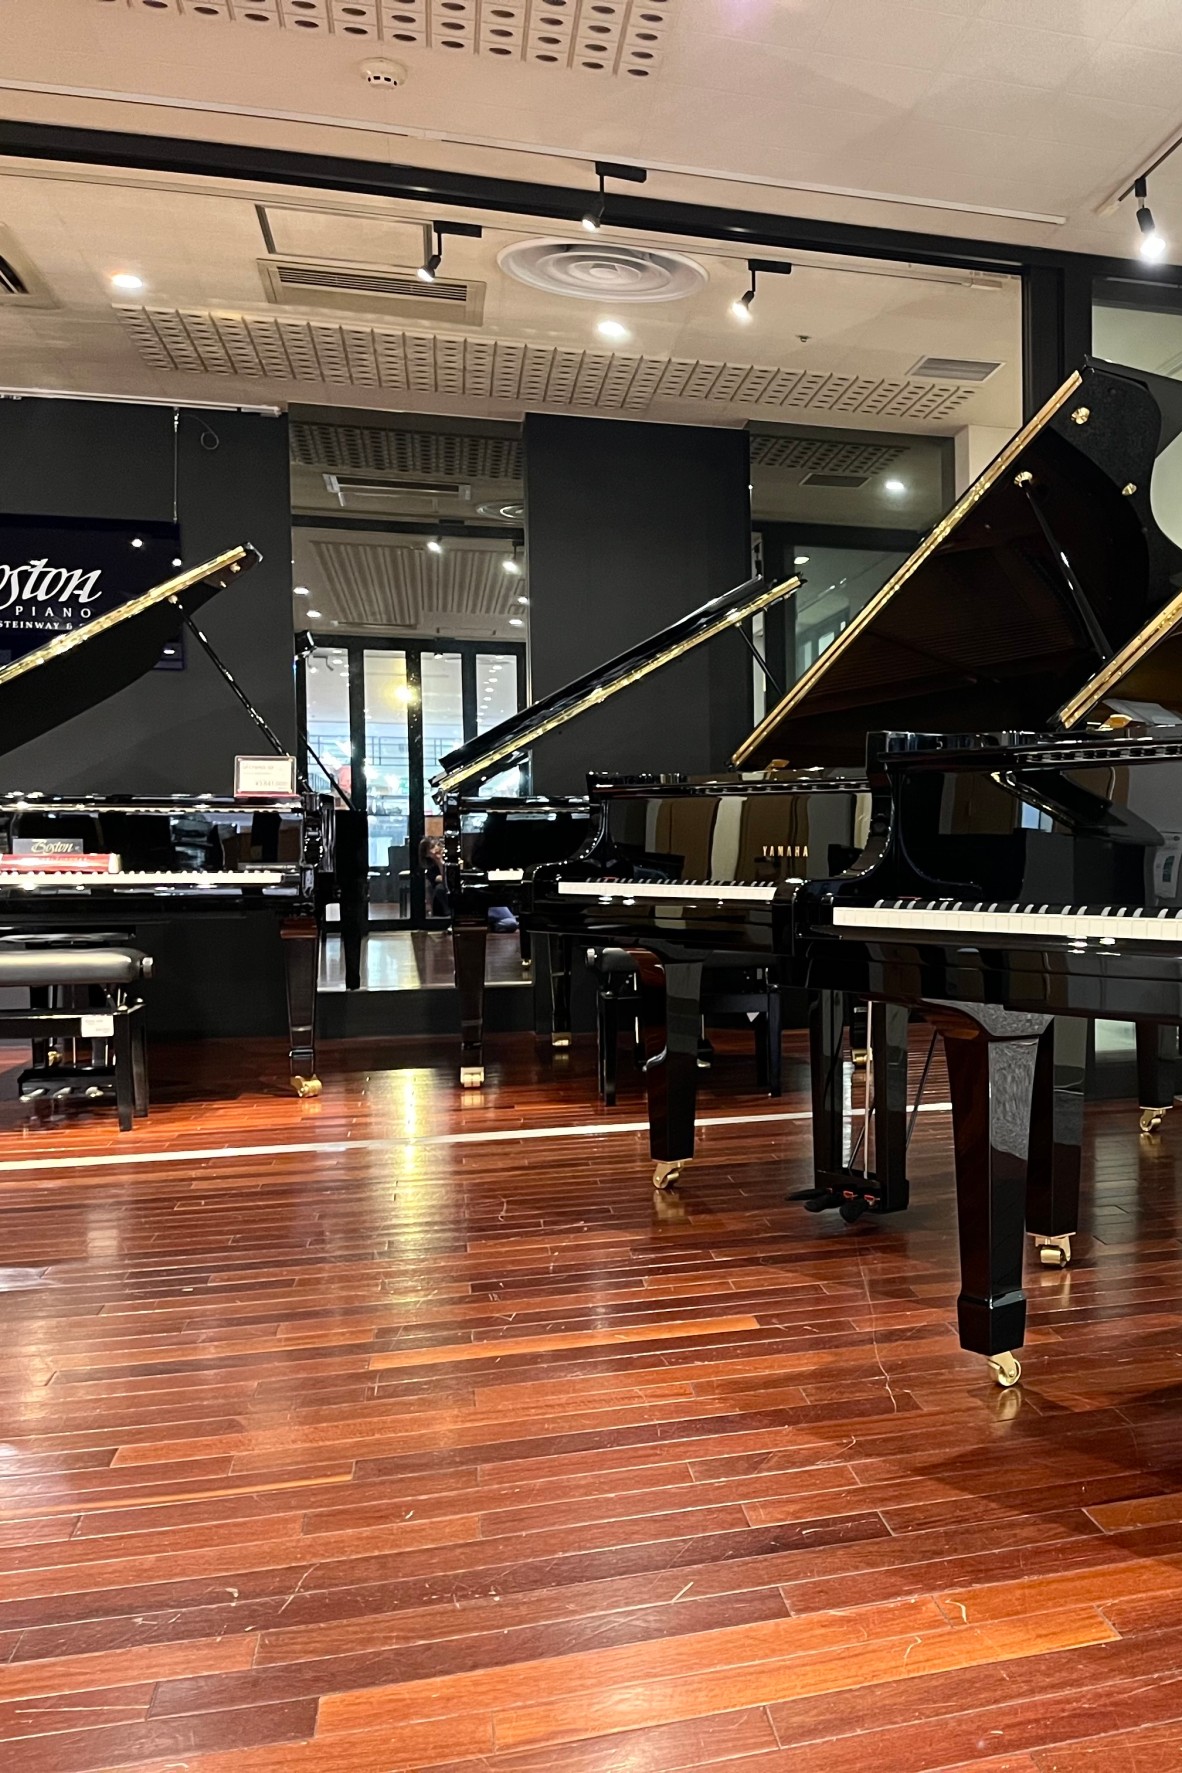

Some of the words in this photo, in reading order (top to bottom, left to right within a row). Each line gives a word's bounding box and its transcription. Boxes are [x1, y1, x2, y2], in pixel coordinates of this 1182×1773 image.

[15, 605, 92, 618] PIANO
[31, 839, 74, 854] Boston
[762, 845, 809, 857] YAMAHA
